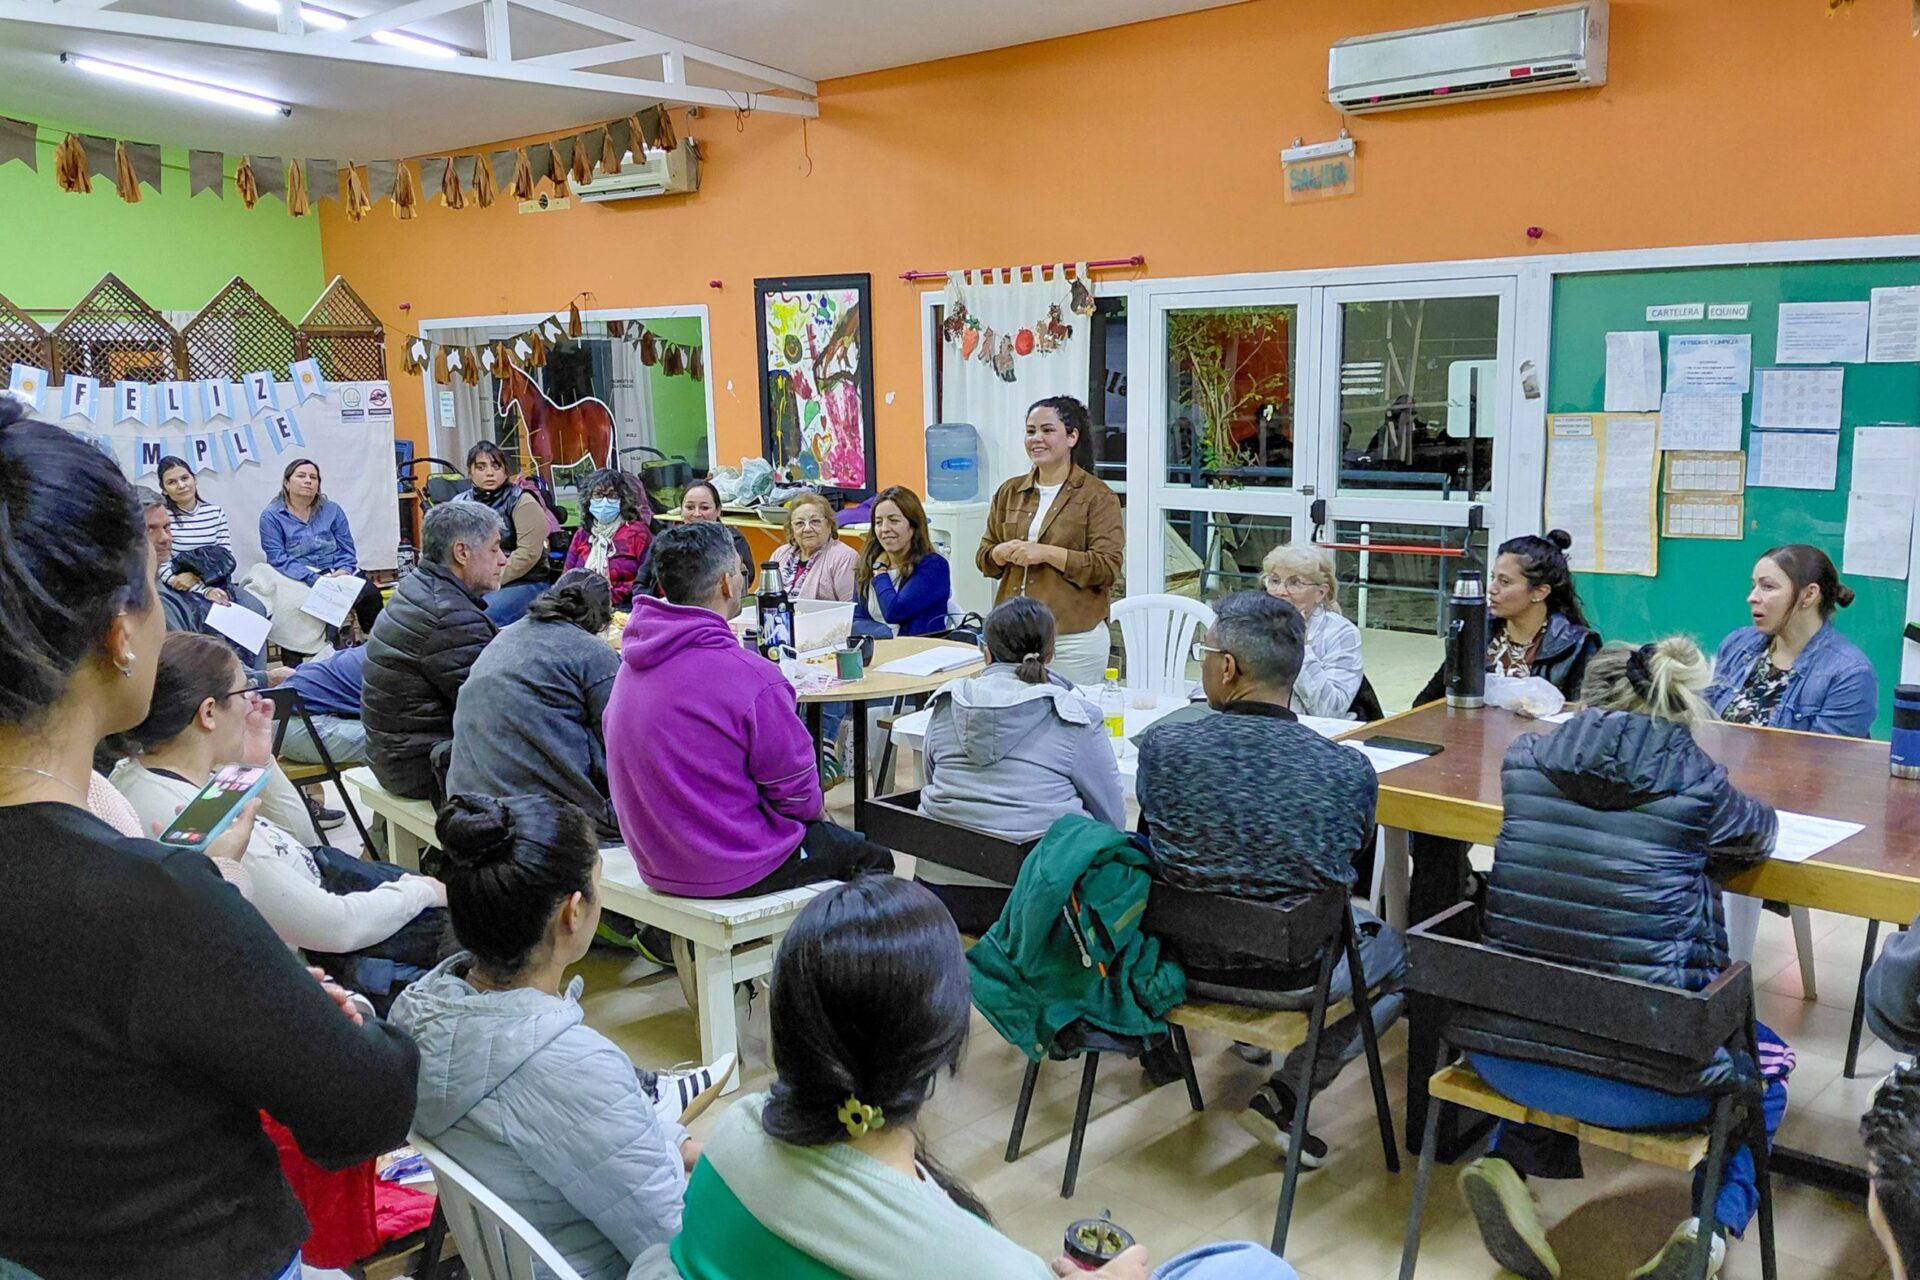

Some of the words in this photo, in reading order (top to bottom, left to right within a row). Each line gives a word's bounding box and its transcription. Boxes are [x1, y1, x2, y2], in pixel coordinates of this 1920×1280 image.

[1290, 162, 1348, 191] SALIDA
[1651, 307, 1700, 318] CARTELERA
[1710, 306, 1746, 317] EQUINO
[75, 378, 267, 411] FELIZ
[86, 416, 291, 465] MPLE
